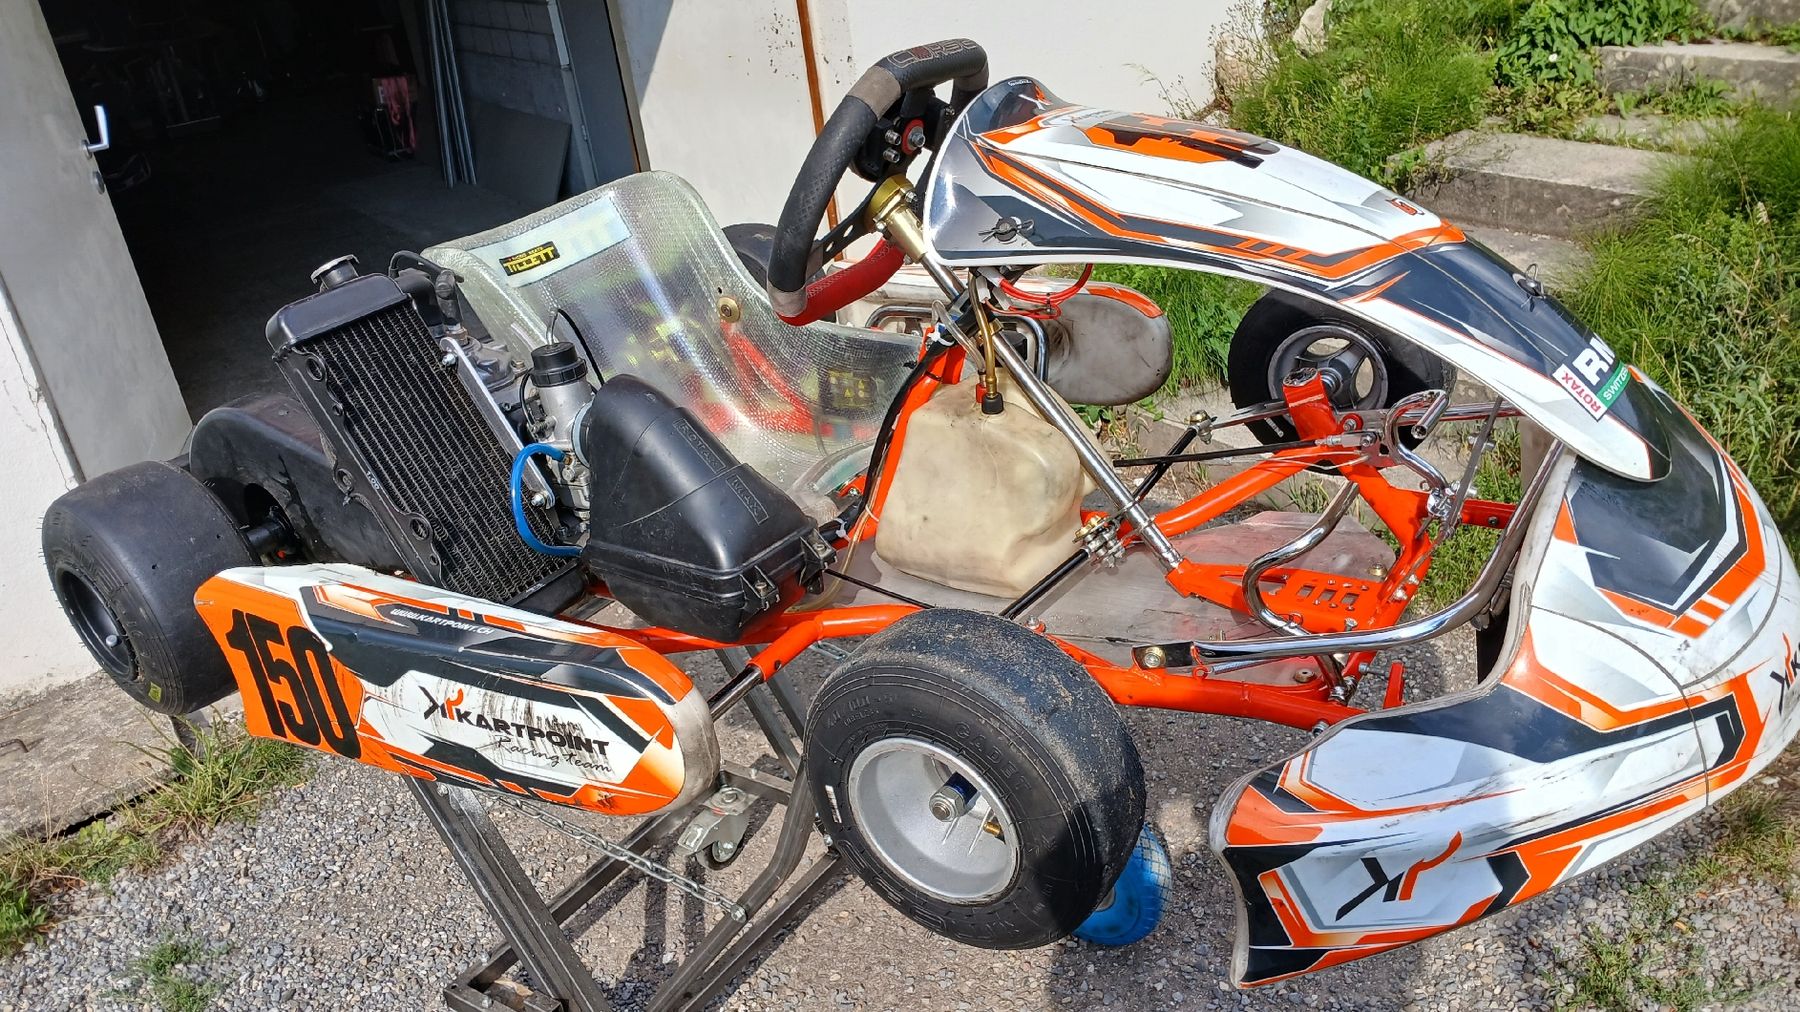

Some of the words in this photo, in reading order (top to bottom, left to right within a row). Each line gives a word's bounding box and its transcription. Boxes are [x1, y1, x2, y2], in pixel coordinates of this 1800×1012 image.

[503, 246, 555, 273] TILLETT
[1561, 373, 1602, 413] ROTAX
[679, 421, 719, 468] ROTAX
[731, 478, 761, 517] MAX
[226, 609, 362, 760] 150
[456, 708, 610, 756] KARTPOINT
[495, 735, 560, 767] Racing
[562, 753, 612, 772] team
[954, 722, 1033, 791] CADET
